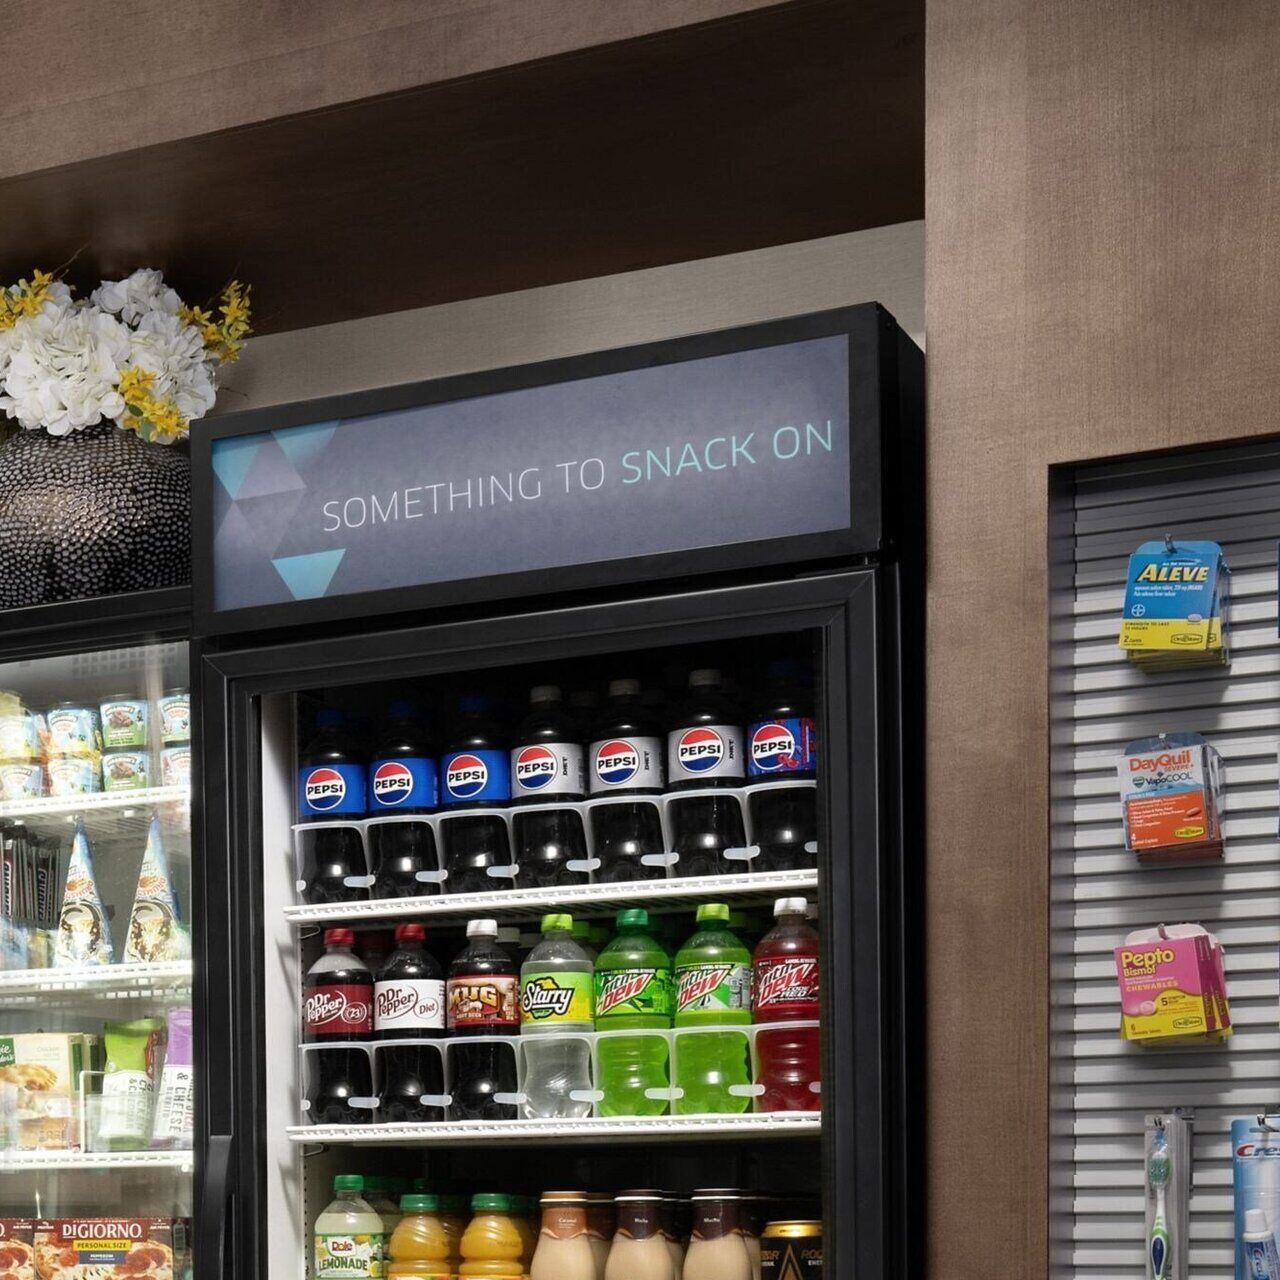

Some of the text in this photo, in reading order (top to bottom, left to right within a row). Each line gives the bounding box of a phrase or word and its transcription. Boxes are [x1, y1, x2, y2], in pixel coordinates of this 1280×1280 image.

[322, 419, 834, 532] SOMETHING TO SNACK ON
[1137, 563, 1210, 582] ALEVE
[680, 744, 721, 756] PEPSI
[753, 740, 792, 754] PEPSI
[598, 756, 637, 769] PEPSI
[1129, 751, 1190, 772] DayQuil
[517, 762, 555, 774] PEPSI
[448, 771, 485, 782] PEPSI
[307, 783, 343, 795] PEPSI
[375, 778, 410, 790] PEPSI
[1121, 948, 1175, 969] Pepto
[1123, 965, 1157, 977] Bismol
[1126, 980, 1179, 992] CHEWABLES
[386, 988, 403, 1001] Dr
[524, 980, 574, 1016] Starry
[377, 993, 415, 1016] Pepper
[1161, 997, 1168, 1006] 5
[419, 1004, 436, 1014] Diet
[169, 1087, 187, 1132] CHEESE
[76, 1242, 128, 1250] PERSONAL SIZE
[331, 1241, 353, 1251] Dole
[319, 1258, 368, 1271] LEMONADE
